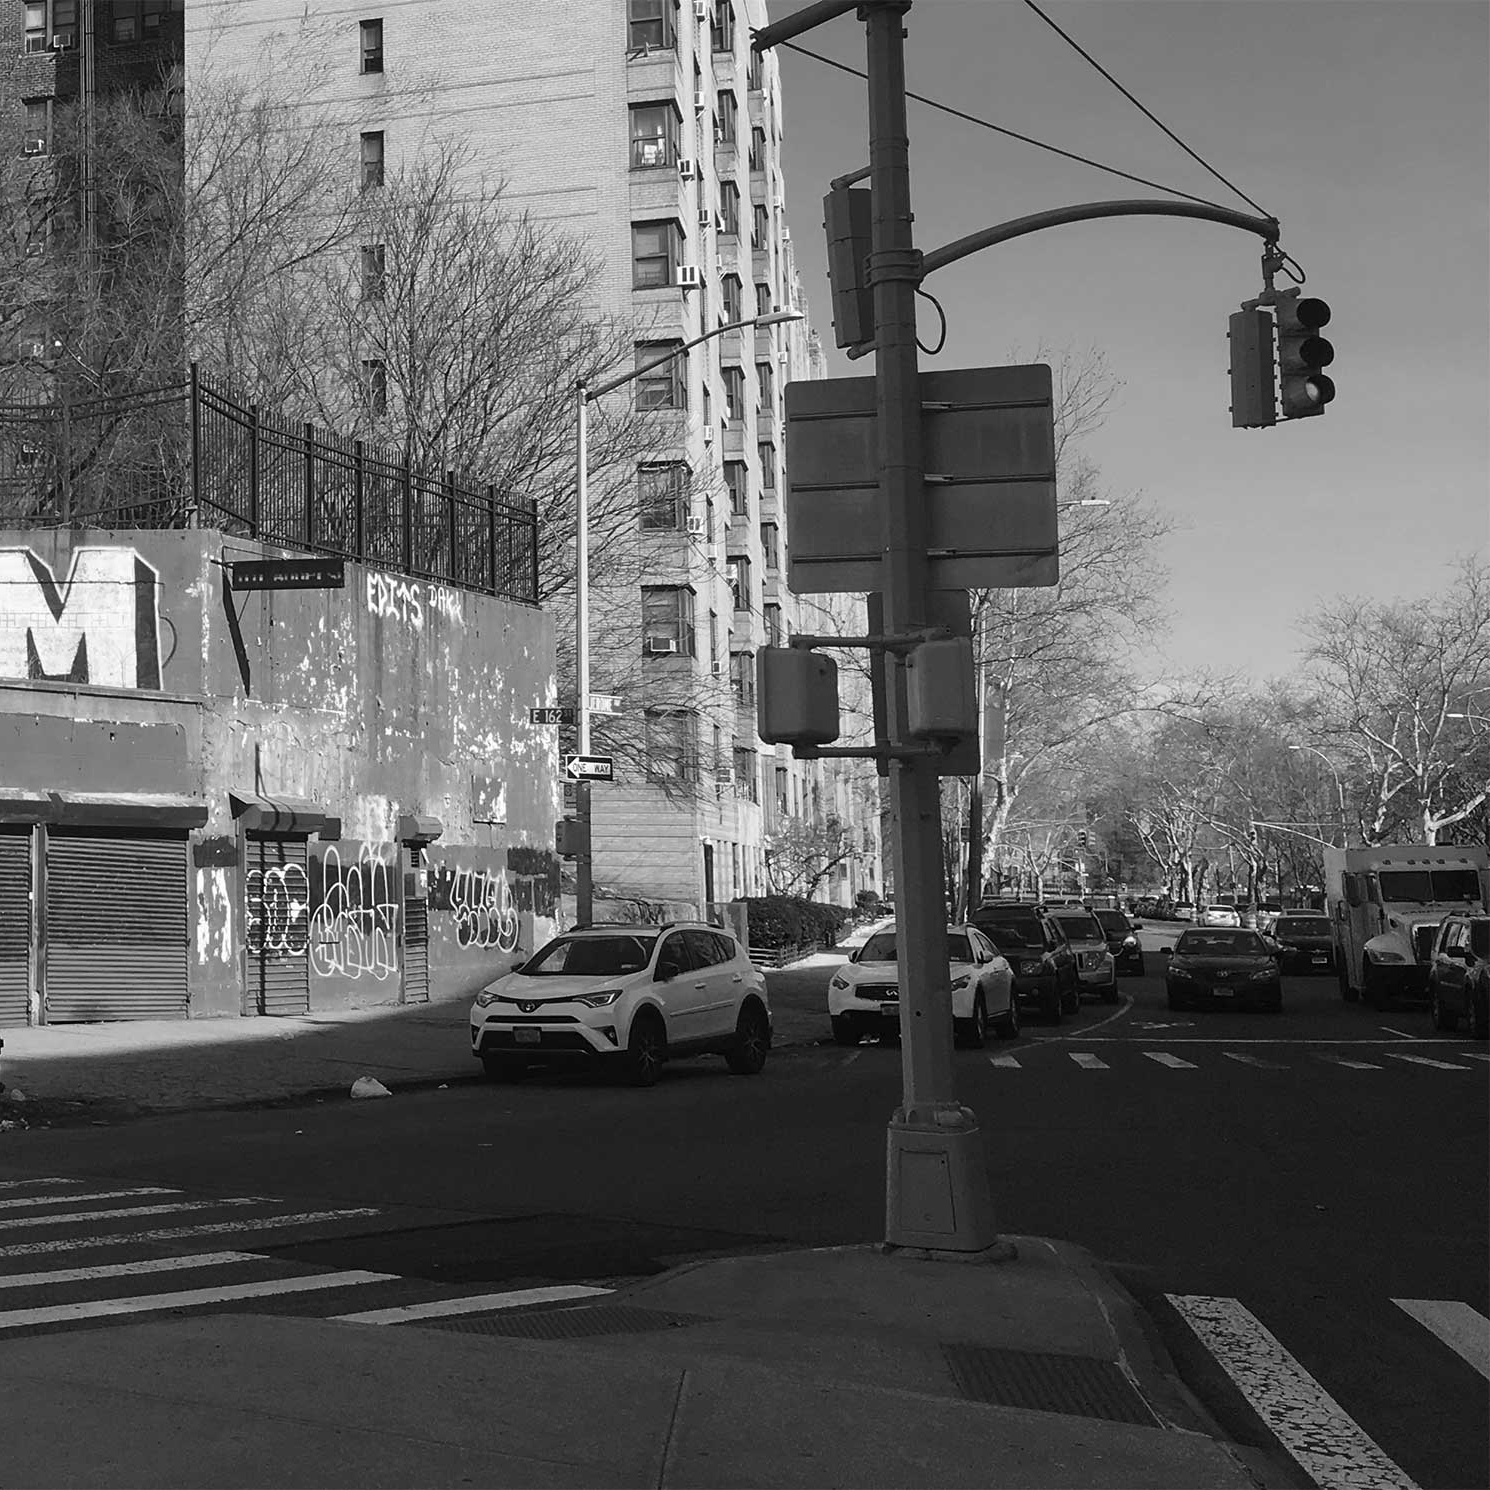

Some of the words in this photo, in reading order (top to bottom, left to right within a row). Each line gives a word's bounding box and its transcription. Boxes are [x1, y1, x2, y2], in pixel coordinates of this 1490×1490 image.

[533, 709, 540, 723] E
[544, 709, 563, 724] 162
[572, 762, 587, 773] ONE
[594, 764, 609, 774] WAY
